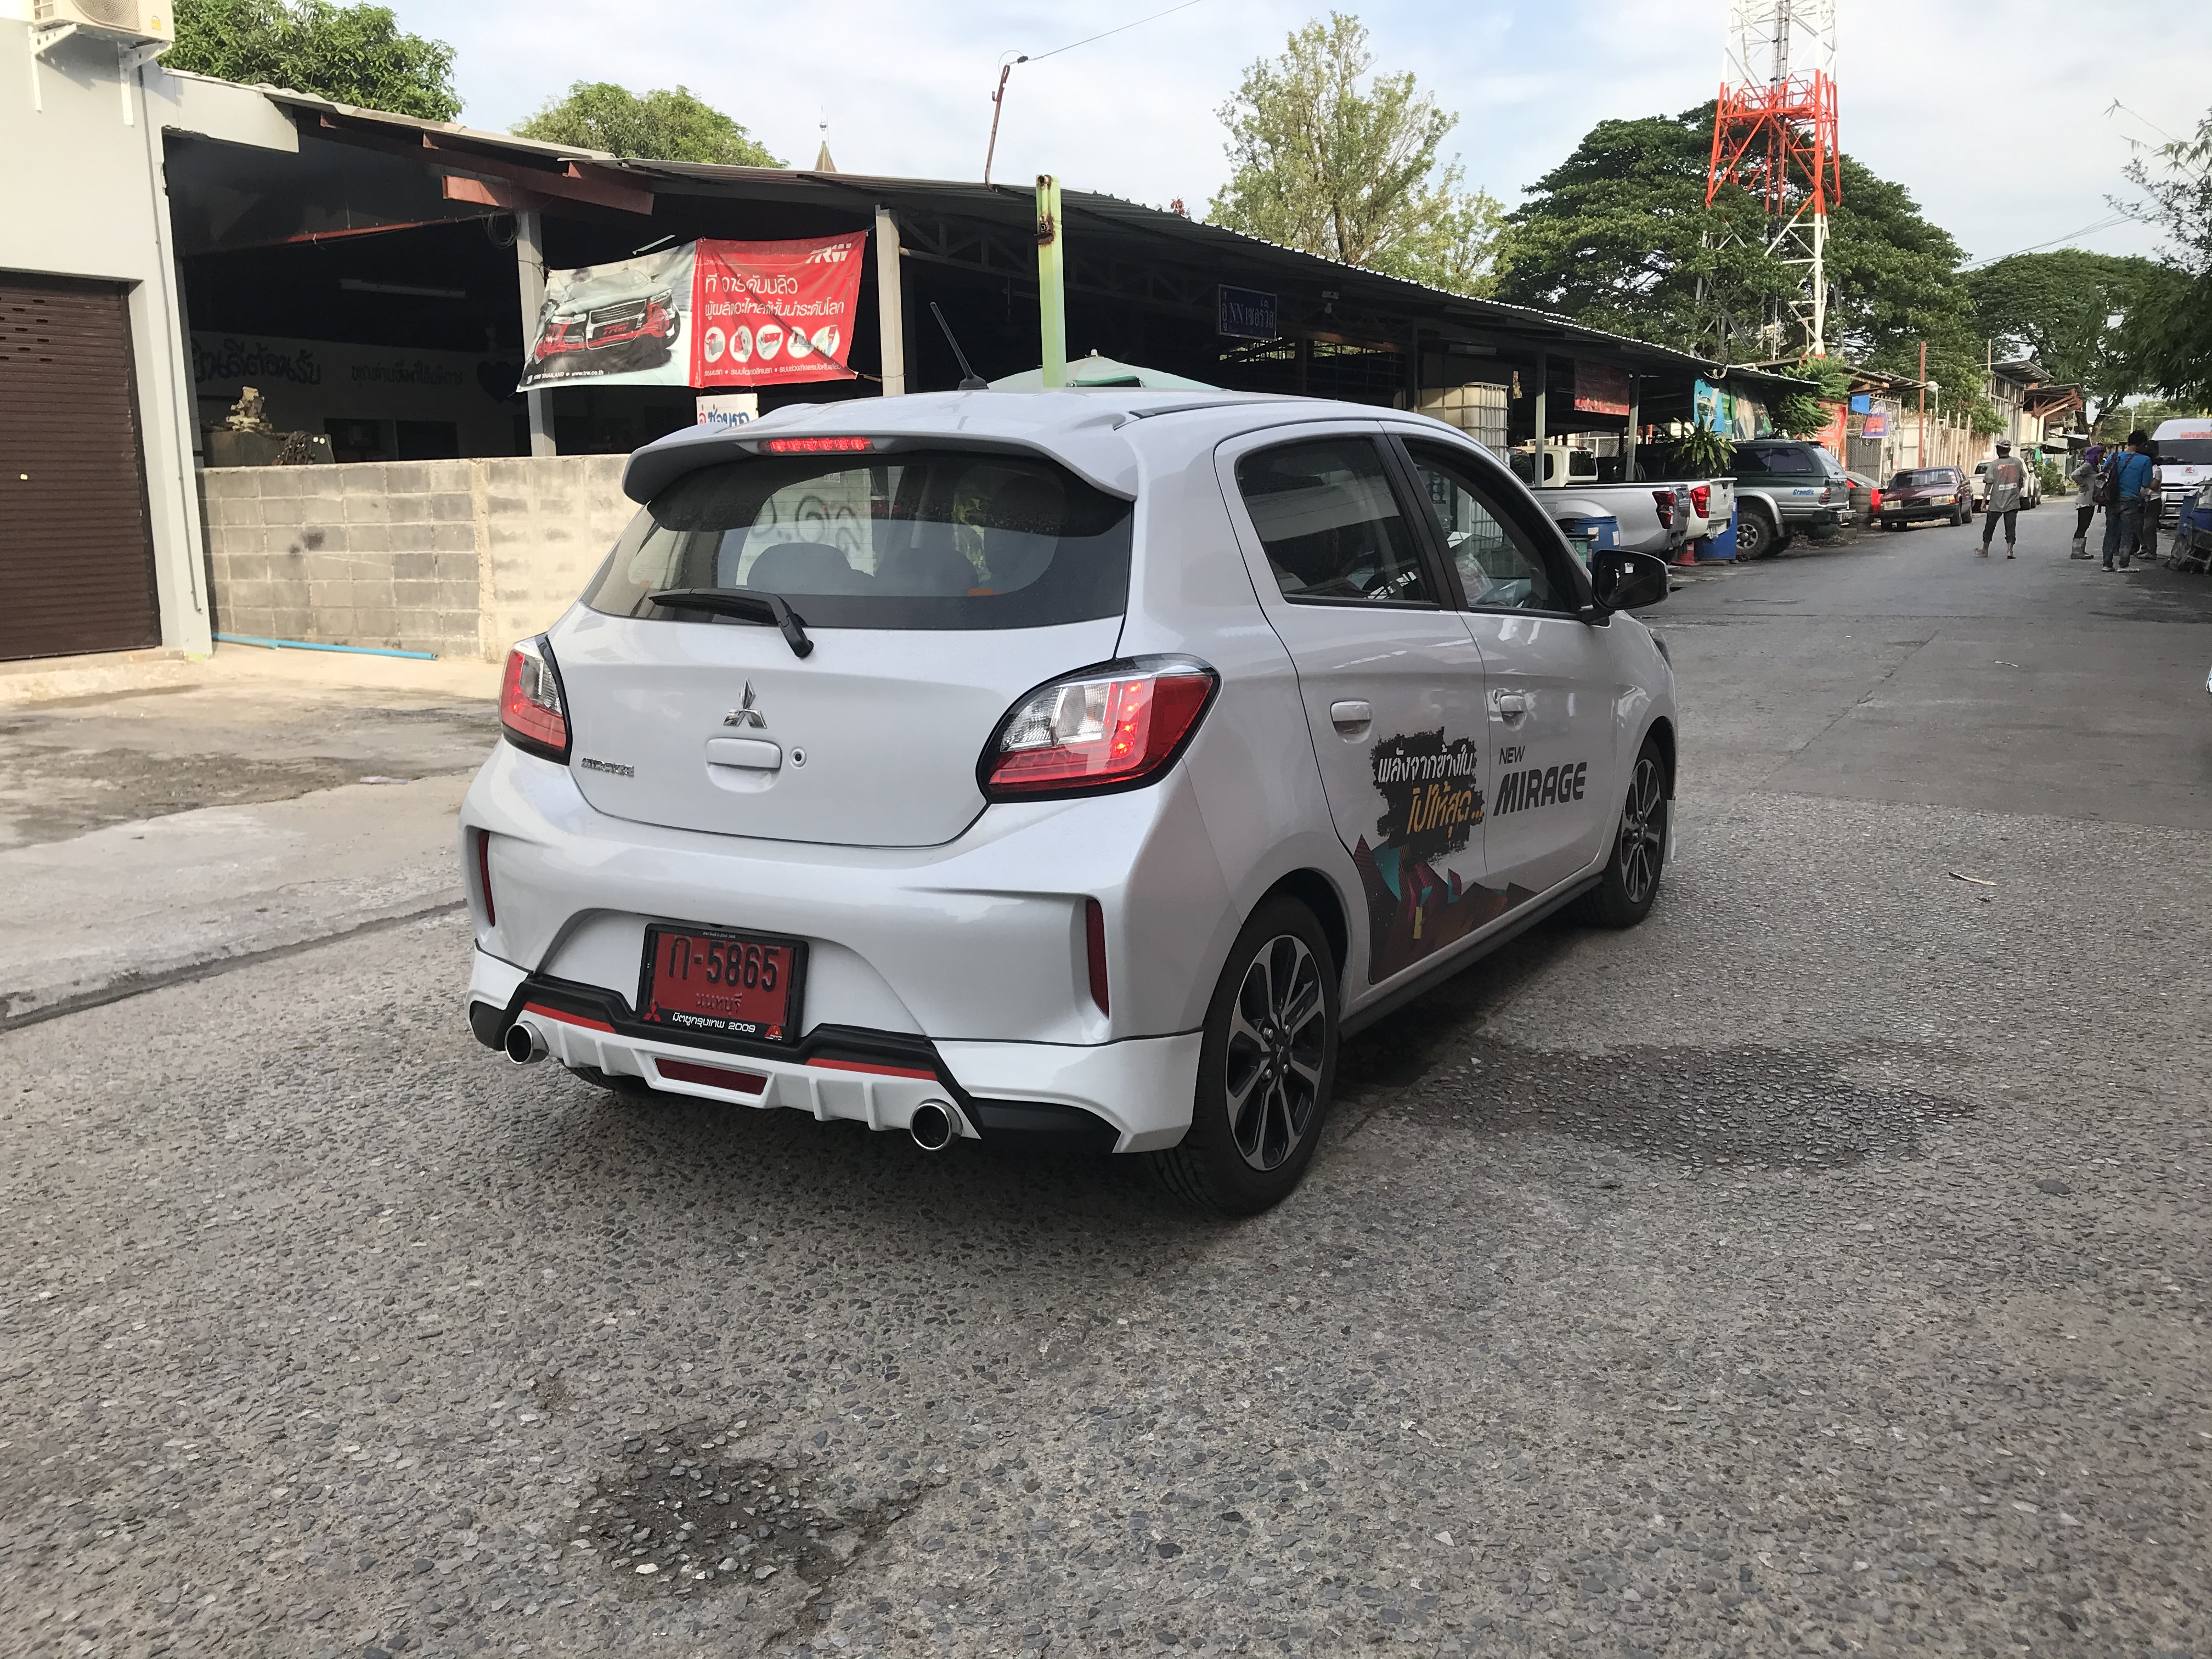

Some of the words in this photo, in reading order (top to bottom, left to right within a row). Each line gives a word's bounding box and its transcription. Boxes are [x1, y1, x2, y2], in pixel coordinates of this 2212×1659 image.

[805, 243, 851, 264] TRW
[706, 274, 718, 294] ที
[1378, 743, 1474, 783] พลังจากข้างใน
[1499, 745, 1526, 765] NEW
[581, 757, 634, 778] MIRAGE
[1493, 761, 1588, 817] MIRAGE
[1406, 780, 1484, 838] ไปให้สุด...
[668, 935, 781, 992] ก-5865
[696, 992, 743, 1018] นนทบุรี
[727, 1022, 756, 1033] 2009
